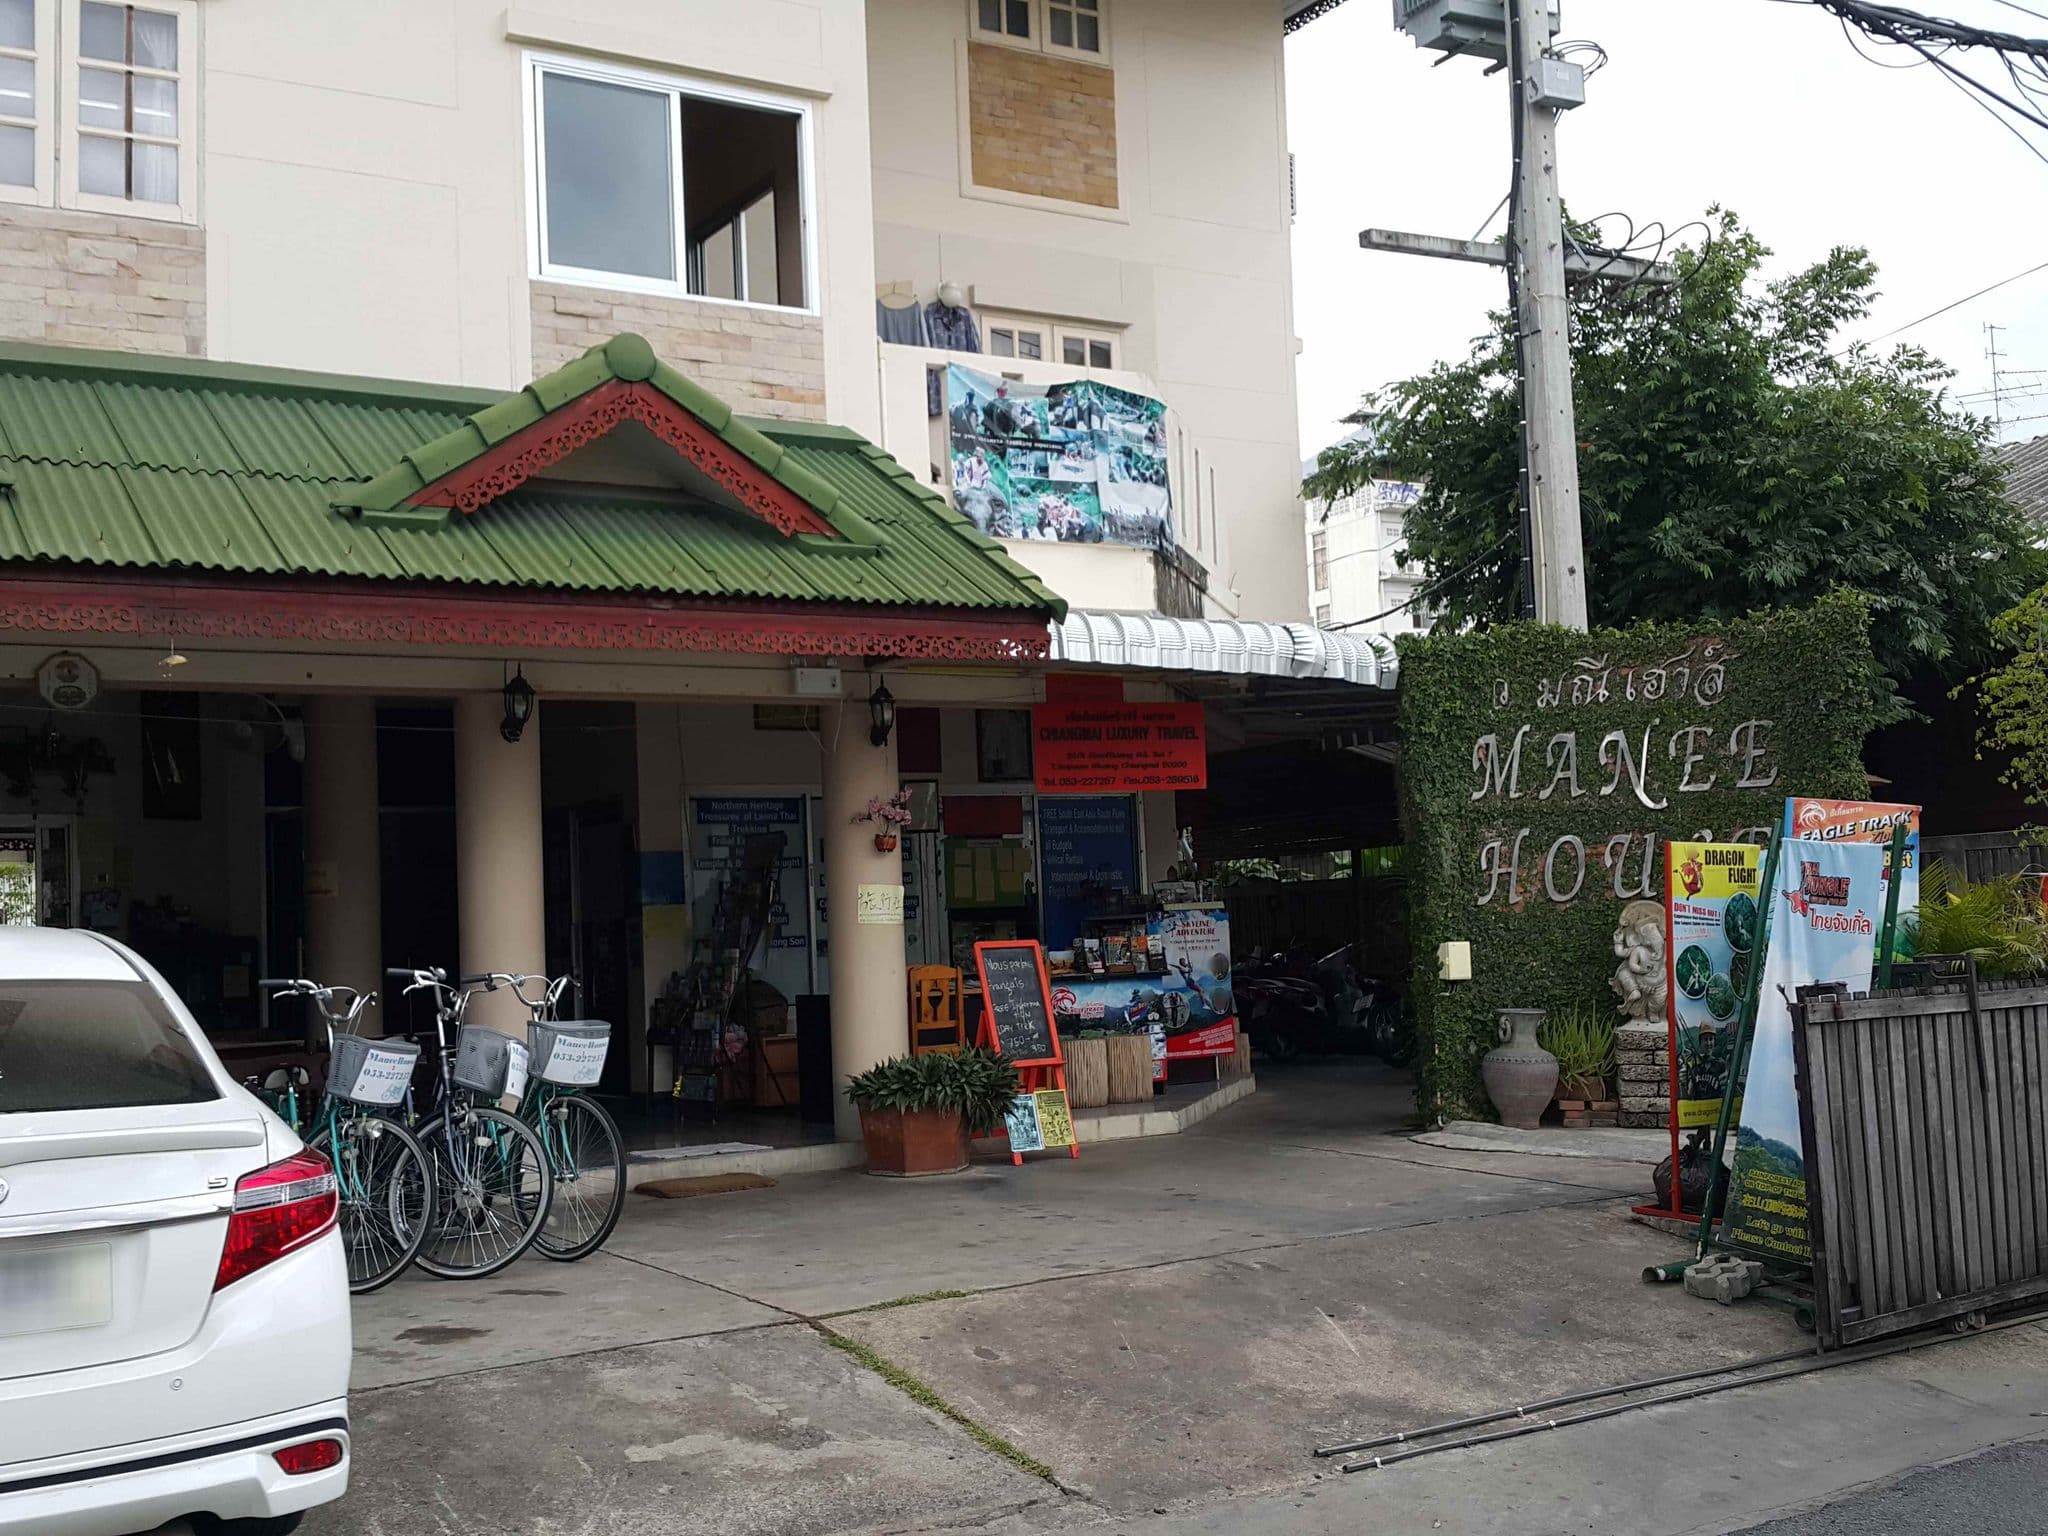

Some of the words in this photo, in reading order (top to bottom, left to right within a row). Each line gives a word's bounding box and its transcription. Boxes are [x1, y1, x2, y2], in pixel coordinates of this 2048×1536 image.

[1040, 727, 1102, 741] CHIANGMAI
[1106, 727, 1150, 740] LUXURY
[1158, 726, 1200, 740] TRAVEL
[1472, 718, 1778, 809] MANEE
[711, 801, 747, 810] Northern
[750, 800, 784, 812] Heritage
[1043, 808, 1058, 818] FREE
[701, 811, 741, 821] Treasures
[1800, 821, 1858, 841] EAGLE
[1859, 809, 1914, 833] TRACK
[1704, 849, 1745, 867] DRAGON
[1477, 827, 1773, 905] HOU
[1728, 867, 1757, 884] FLIGHT
[1804, 876, 1850, 898] JUNGLE
[1674, 902, 1690, 913] DON'T
[1692, 905, 1706, 916] MISS
[1707, 907, 1718, 917] OUT
[1182, 920, 1209, 928] SKYLINE
[1176, 928, 1215, 936] ADVENTURE
[789, 937, 807, 947] Son
[984, 958, 1009, 970] Nous
[1749, 1169, 1792, 1185] RAINFOREST
[1746, 1215, 1770, 1231] Let's
[1770, 1223, 1784, 1235] go
[1785, 1226, 1806, 1240] with
[1731, 1227, 1764, 1245] Please
[1764, 1236, 1803, 1255] Contact
